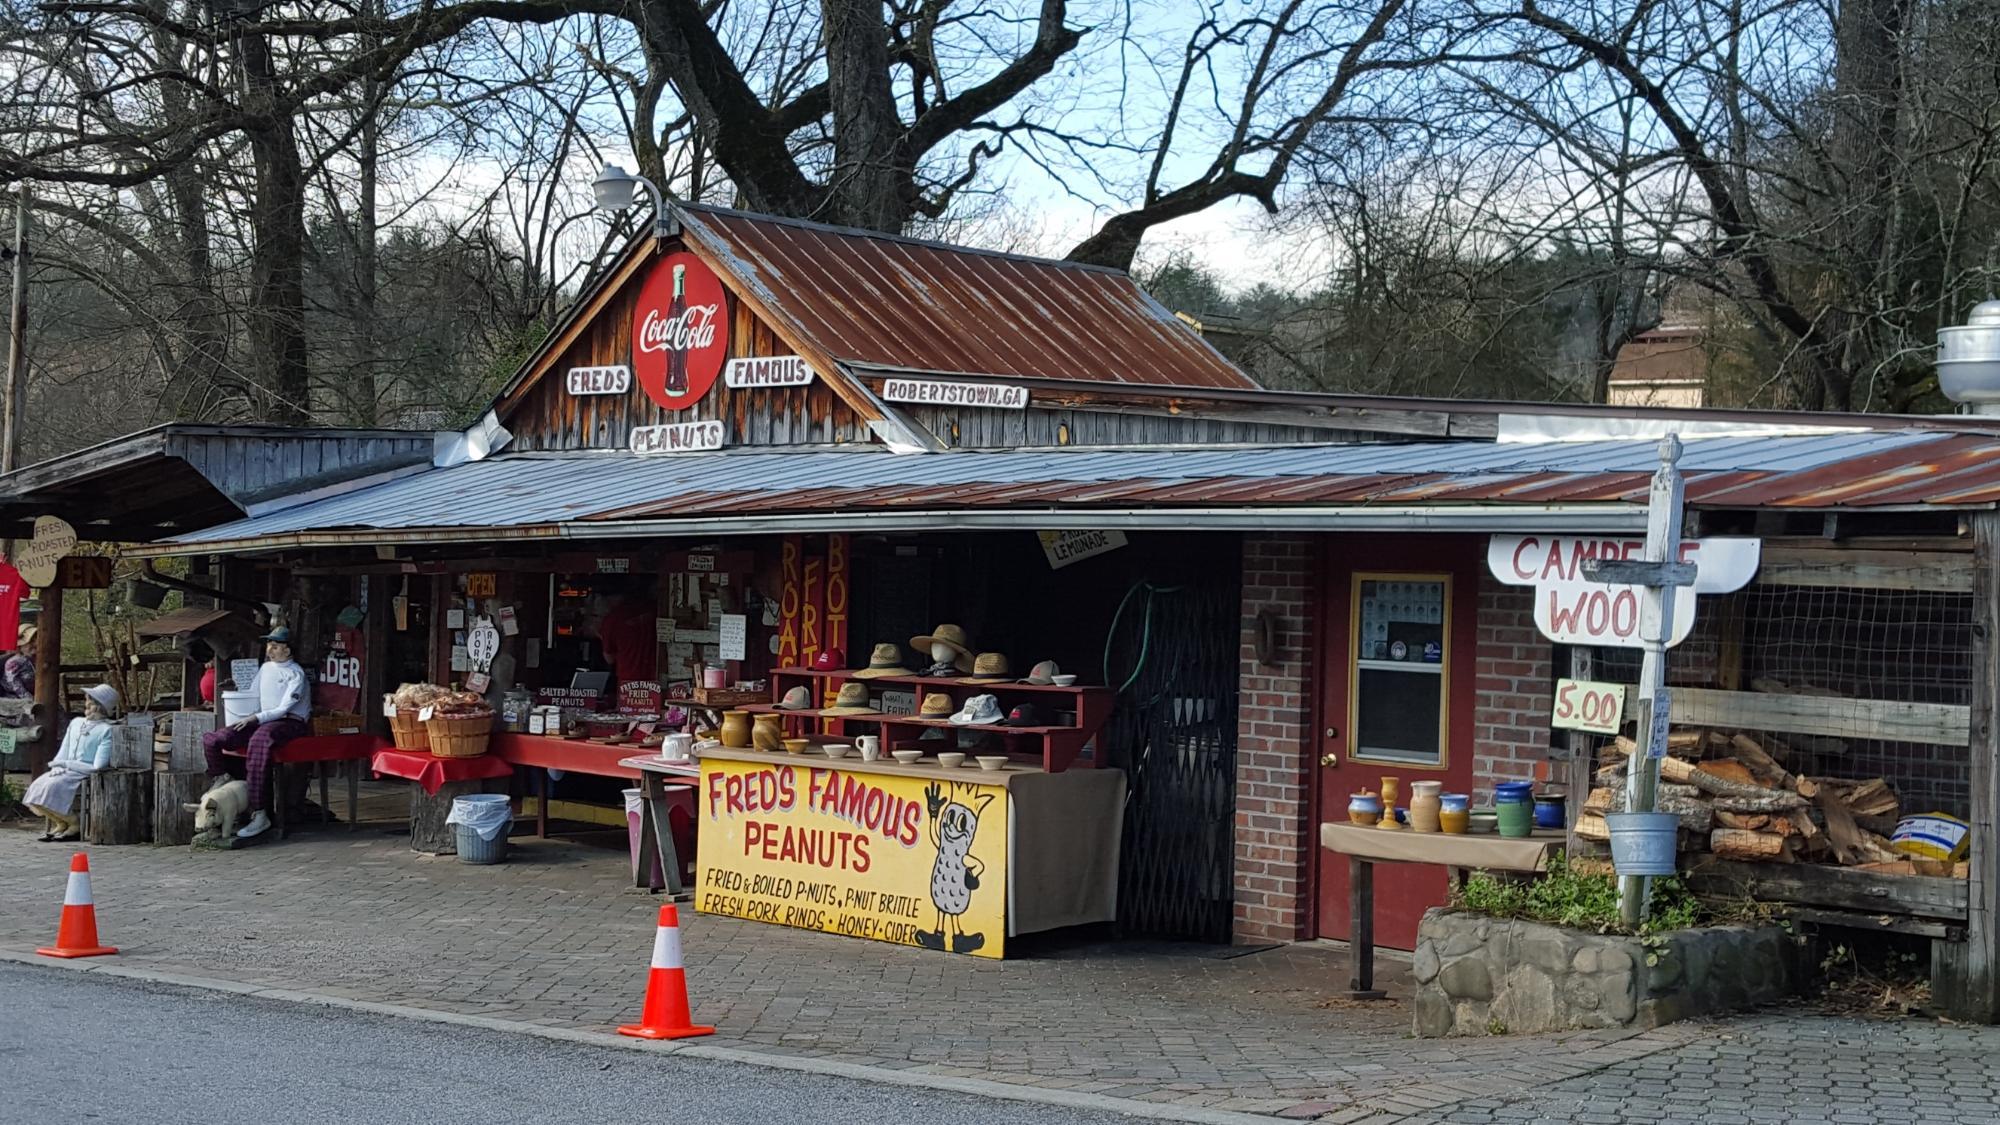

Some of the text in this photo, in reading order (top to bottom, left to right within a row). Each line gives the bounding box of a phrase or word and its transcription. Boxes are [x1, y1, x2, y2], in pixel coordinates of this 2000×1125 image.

[640, 303, 719, 353] Coca-Cola
[570, 369, 626, 393] FREDS
[734, 358, 806, 384] FAMOUS
[633, 423, 719, 450] PEANUTS
[32, 535, 76, 553] ROASTED
[1053, 532, 1109, 561] LEMONADE
[467, 574, 496, 596] OPEN
[1551, 590, 1637, 637] WOO
[473, 630, 481, 667] PORK
[484, 630, 492, 669] RINDS
[552, 697, 585, 706] PEANUTS
[569, 687, 598, 697] ROASTED
[628, 689, 649, 698] FRIED
[1557, 685, 1617, 723] 5.00
[708, 764, 921, 847] FRED'S FAMOUS
[744, 821, 871, 873] PEANUTS
[706, 868, 742, 891] FRIED
[743, 878, 752, 894] &
[752, 874, 792, 899] BOILED
[878, 893, 922, 919] BRITTLE
[704, 893, 744, 916] FRESH
[747, 900, 781, 921] PORK
[785, 906, 826, 930] RINDS
